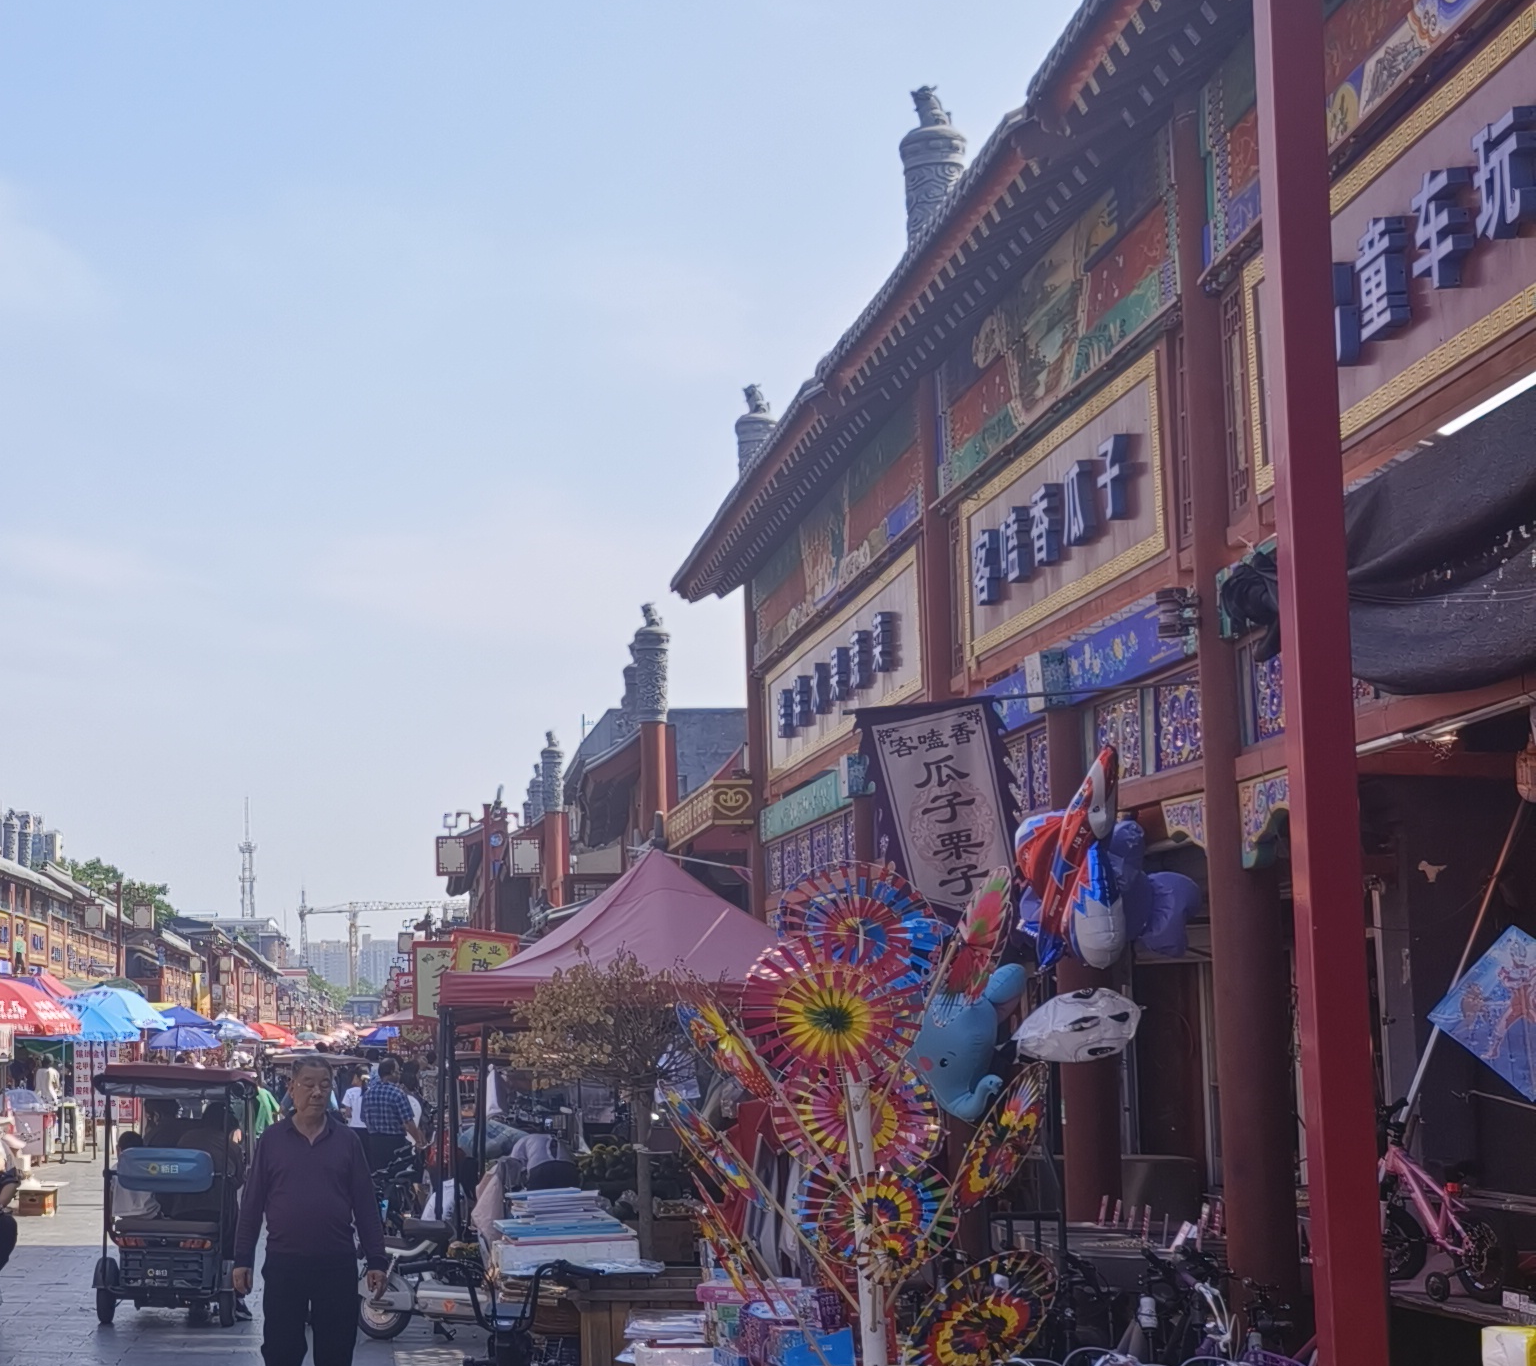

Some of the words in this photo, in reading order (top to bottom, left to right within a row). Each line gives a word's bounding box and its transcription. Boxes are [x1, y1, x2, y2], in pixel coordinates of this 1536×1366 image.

[973, 434, 1126, 606] 客嗑香瓜子
[889, 721, 976, 758] 客嗑香
[914, 754, 990, 897] 瓜子栗子
[468, 941, 502, 957] 专业
